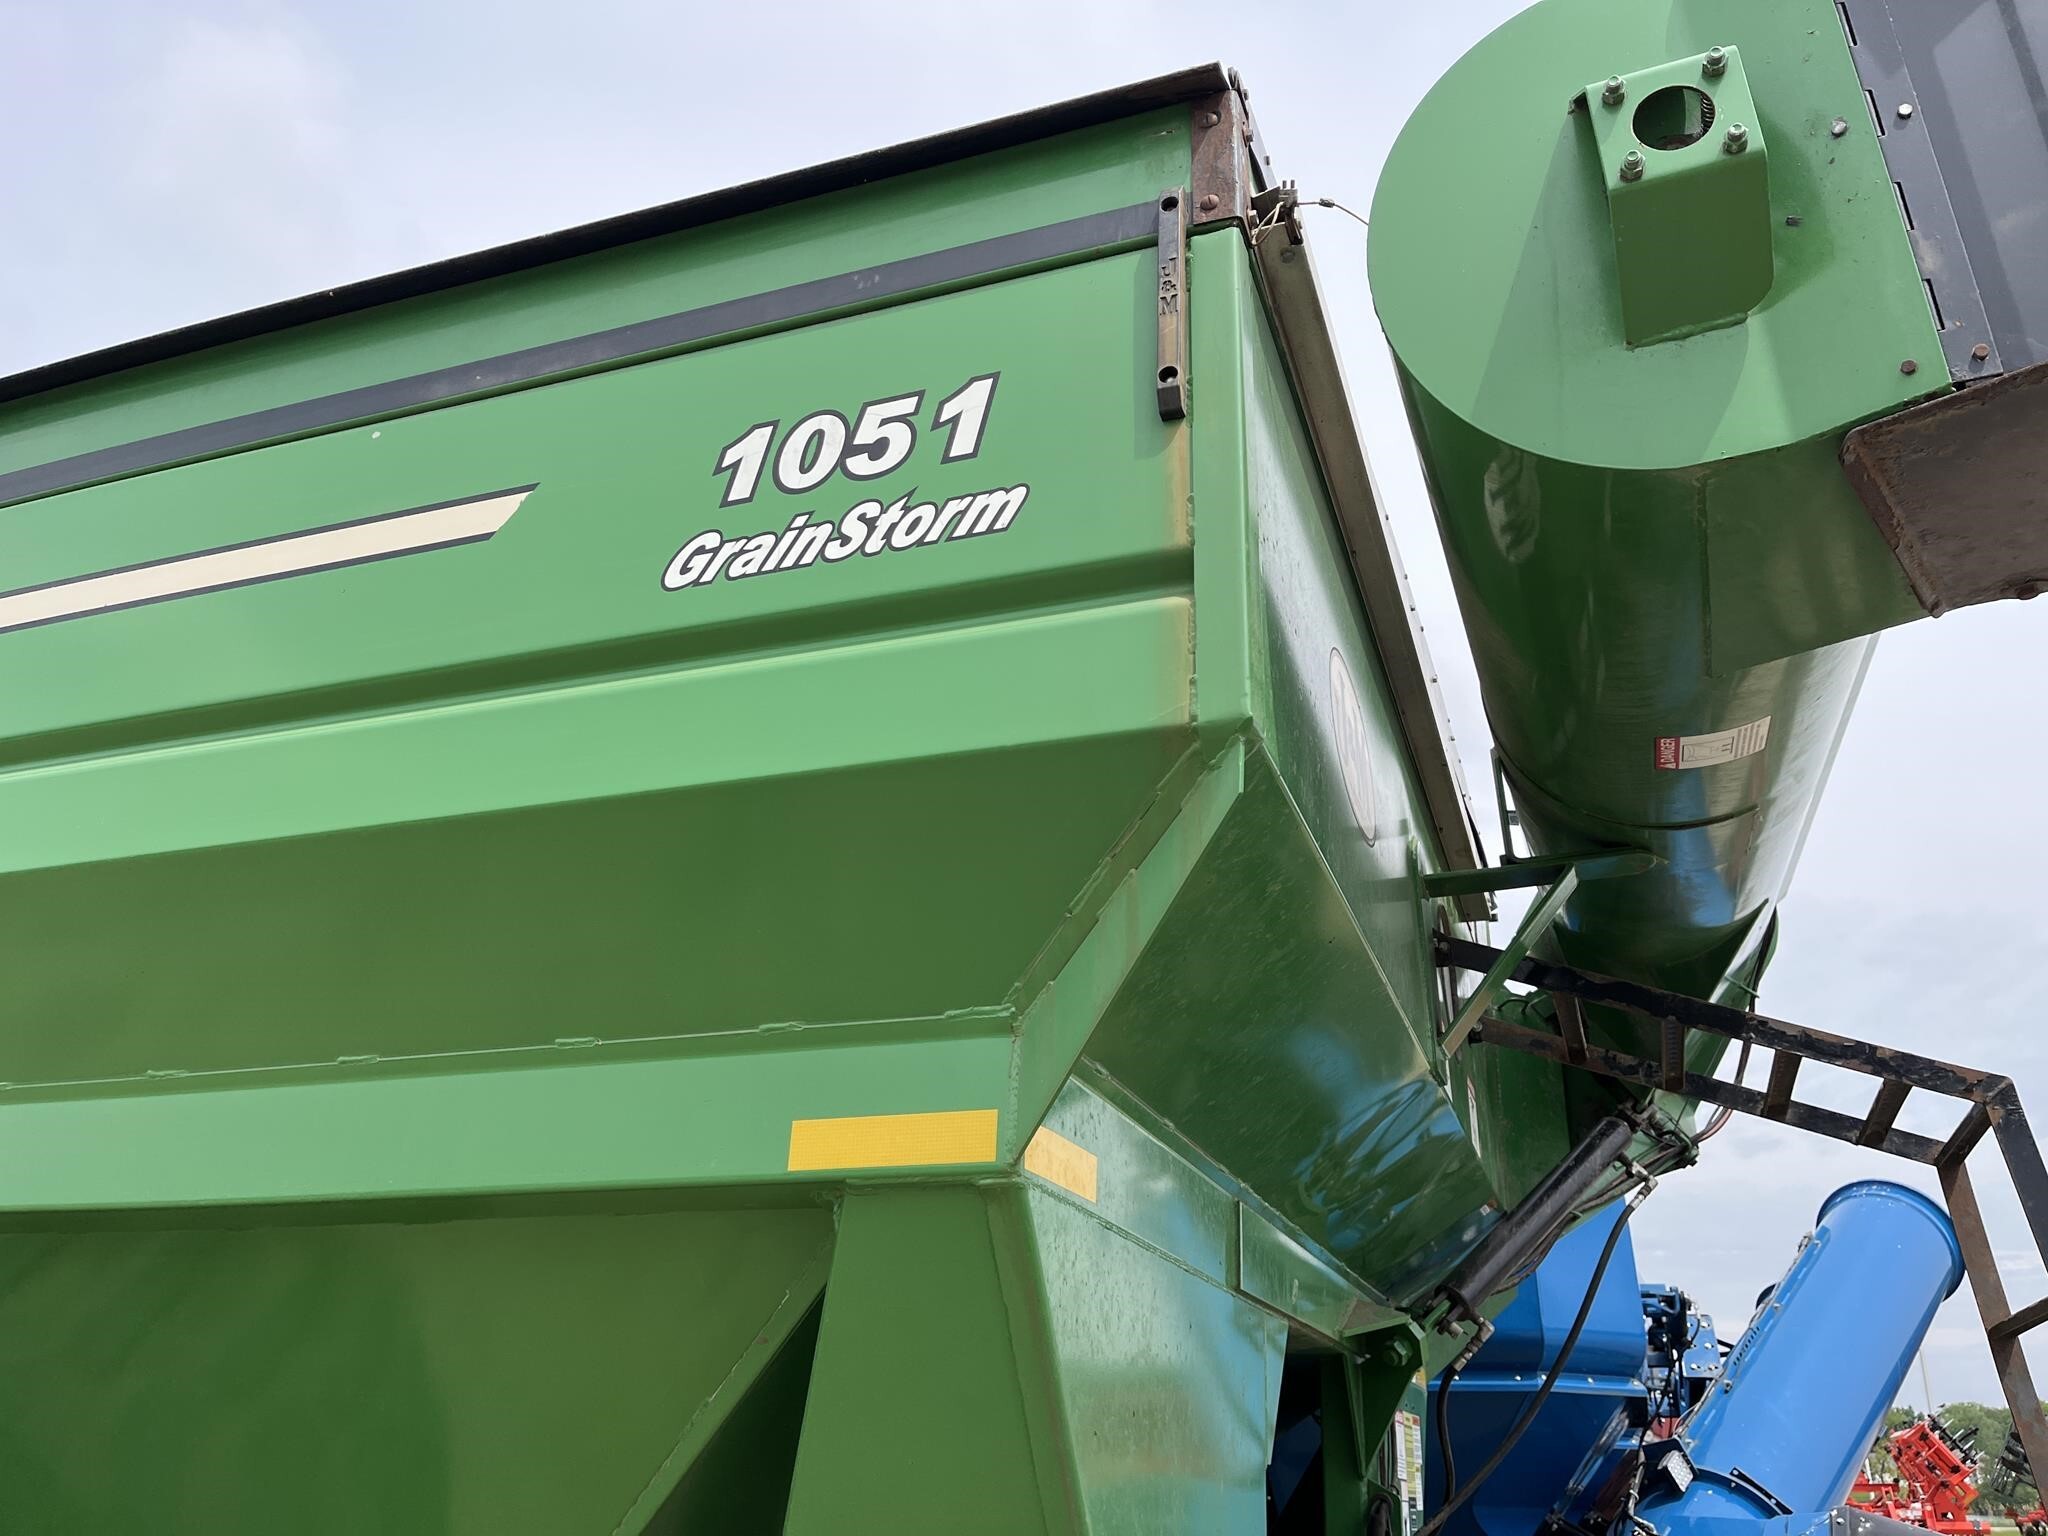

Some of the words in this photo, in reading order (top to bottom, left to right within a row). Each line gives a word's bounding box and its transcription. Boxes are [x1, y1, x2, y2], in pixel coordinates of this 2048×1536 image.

[713, 372, 1000, 507] 1051
[662, 486, 1030, 591] GrainStorm
[1660, 738, 1676, 763] DANGER
